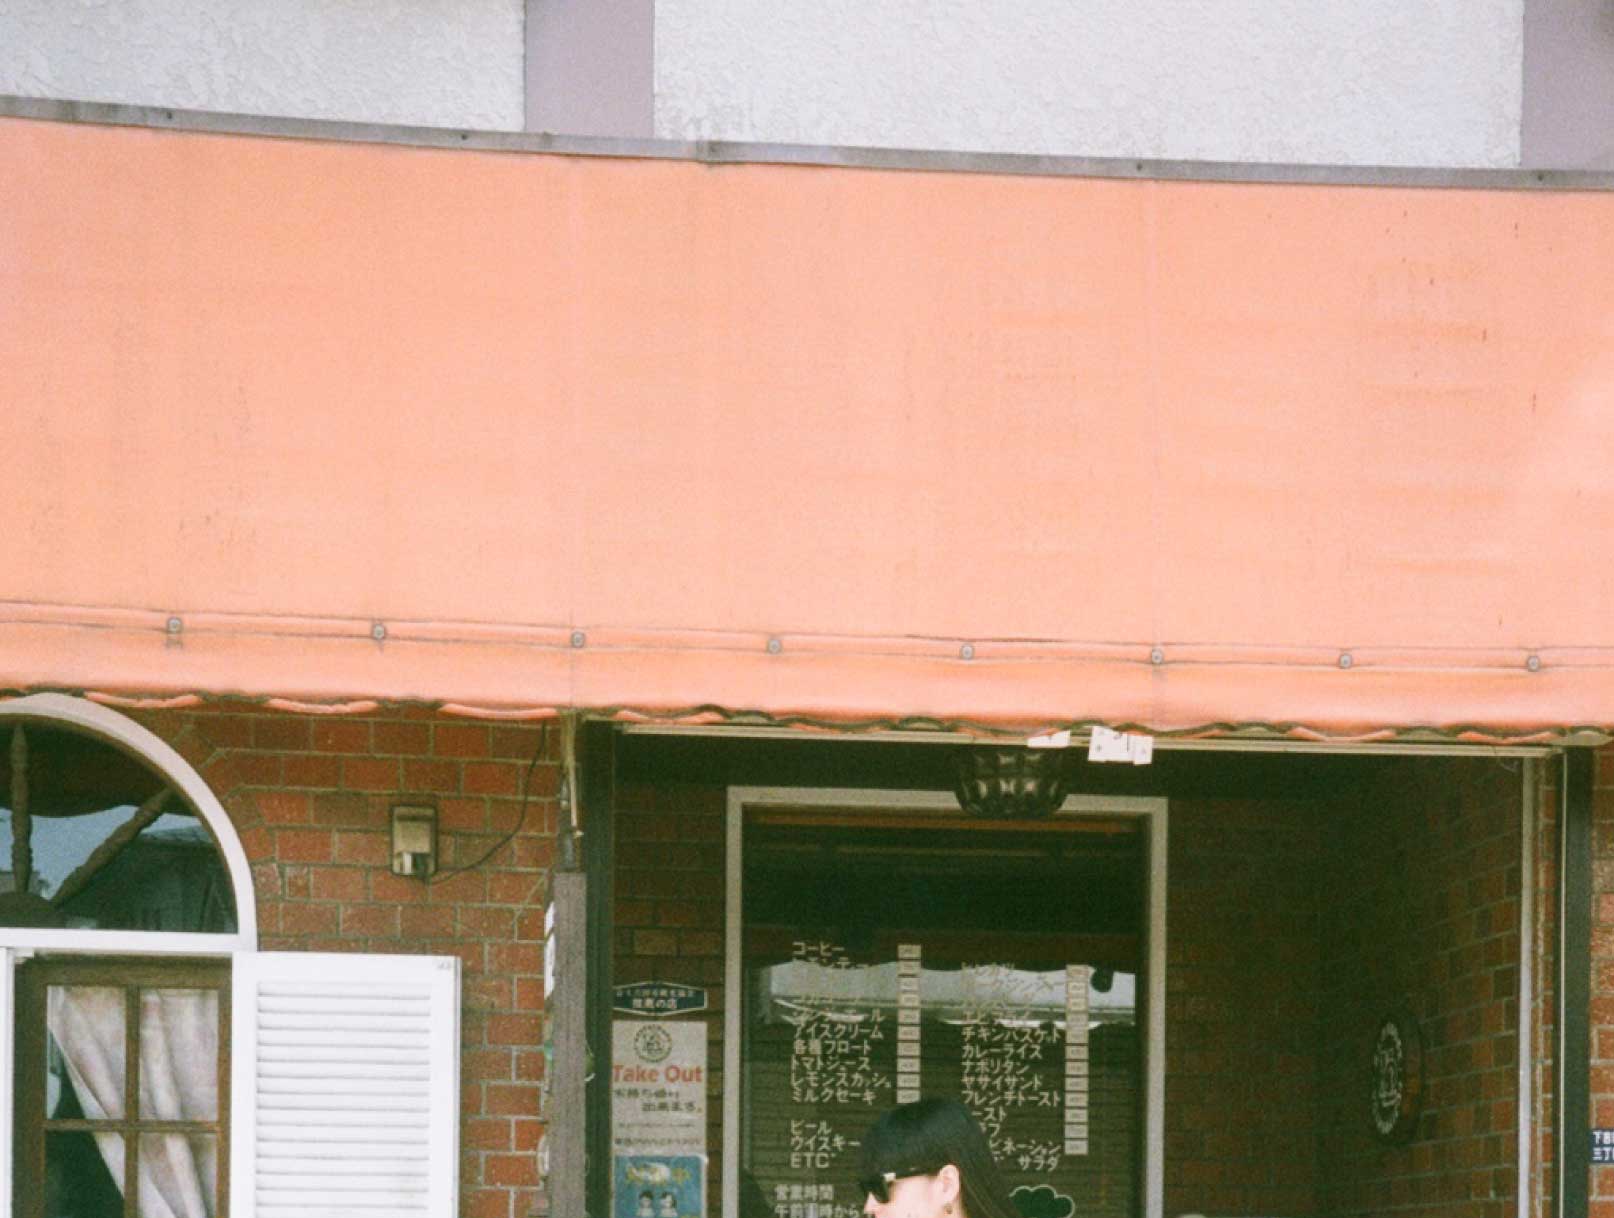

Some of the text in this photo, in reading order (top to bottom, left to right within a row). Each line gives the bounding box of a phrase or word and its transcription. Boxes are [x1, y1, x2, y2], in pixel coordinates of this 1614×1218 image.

[792, 941, 845, 956] コーヒー
[962, 1044, 1042, 1060] カレーライス
[791, 1055, 871, 1071] トマトジュース
[961, 1059, 1030, 1075] ナポリタン
[613, 1065, 703, 1083] Take Out
[791, 1072, 892, 1088] レモンスカッシュ
[961, 1075, 1042, 1091] ヤサイサンド
[792, 1088, 877, 1105] ミルクセーキ
[961, 1090, 1061, 1107] フレンチトースト
[971, 1106, 1007, 1122] ースト
[790, 1119, 832, 1135] ビール
[1017, 1154, 1061, 1172] サラダ
